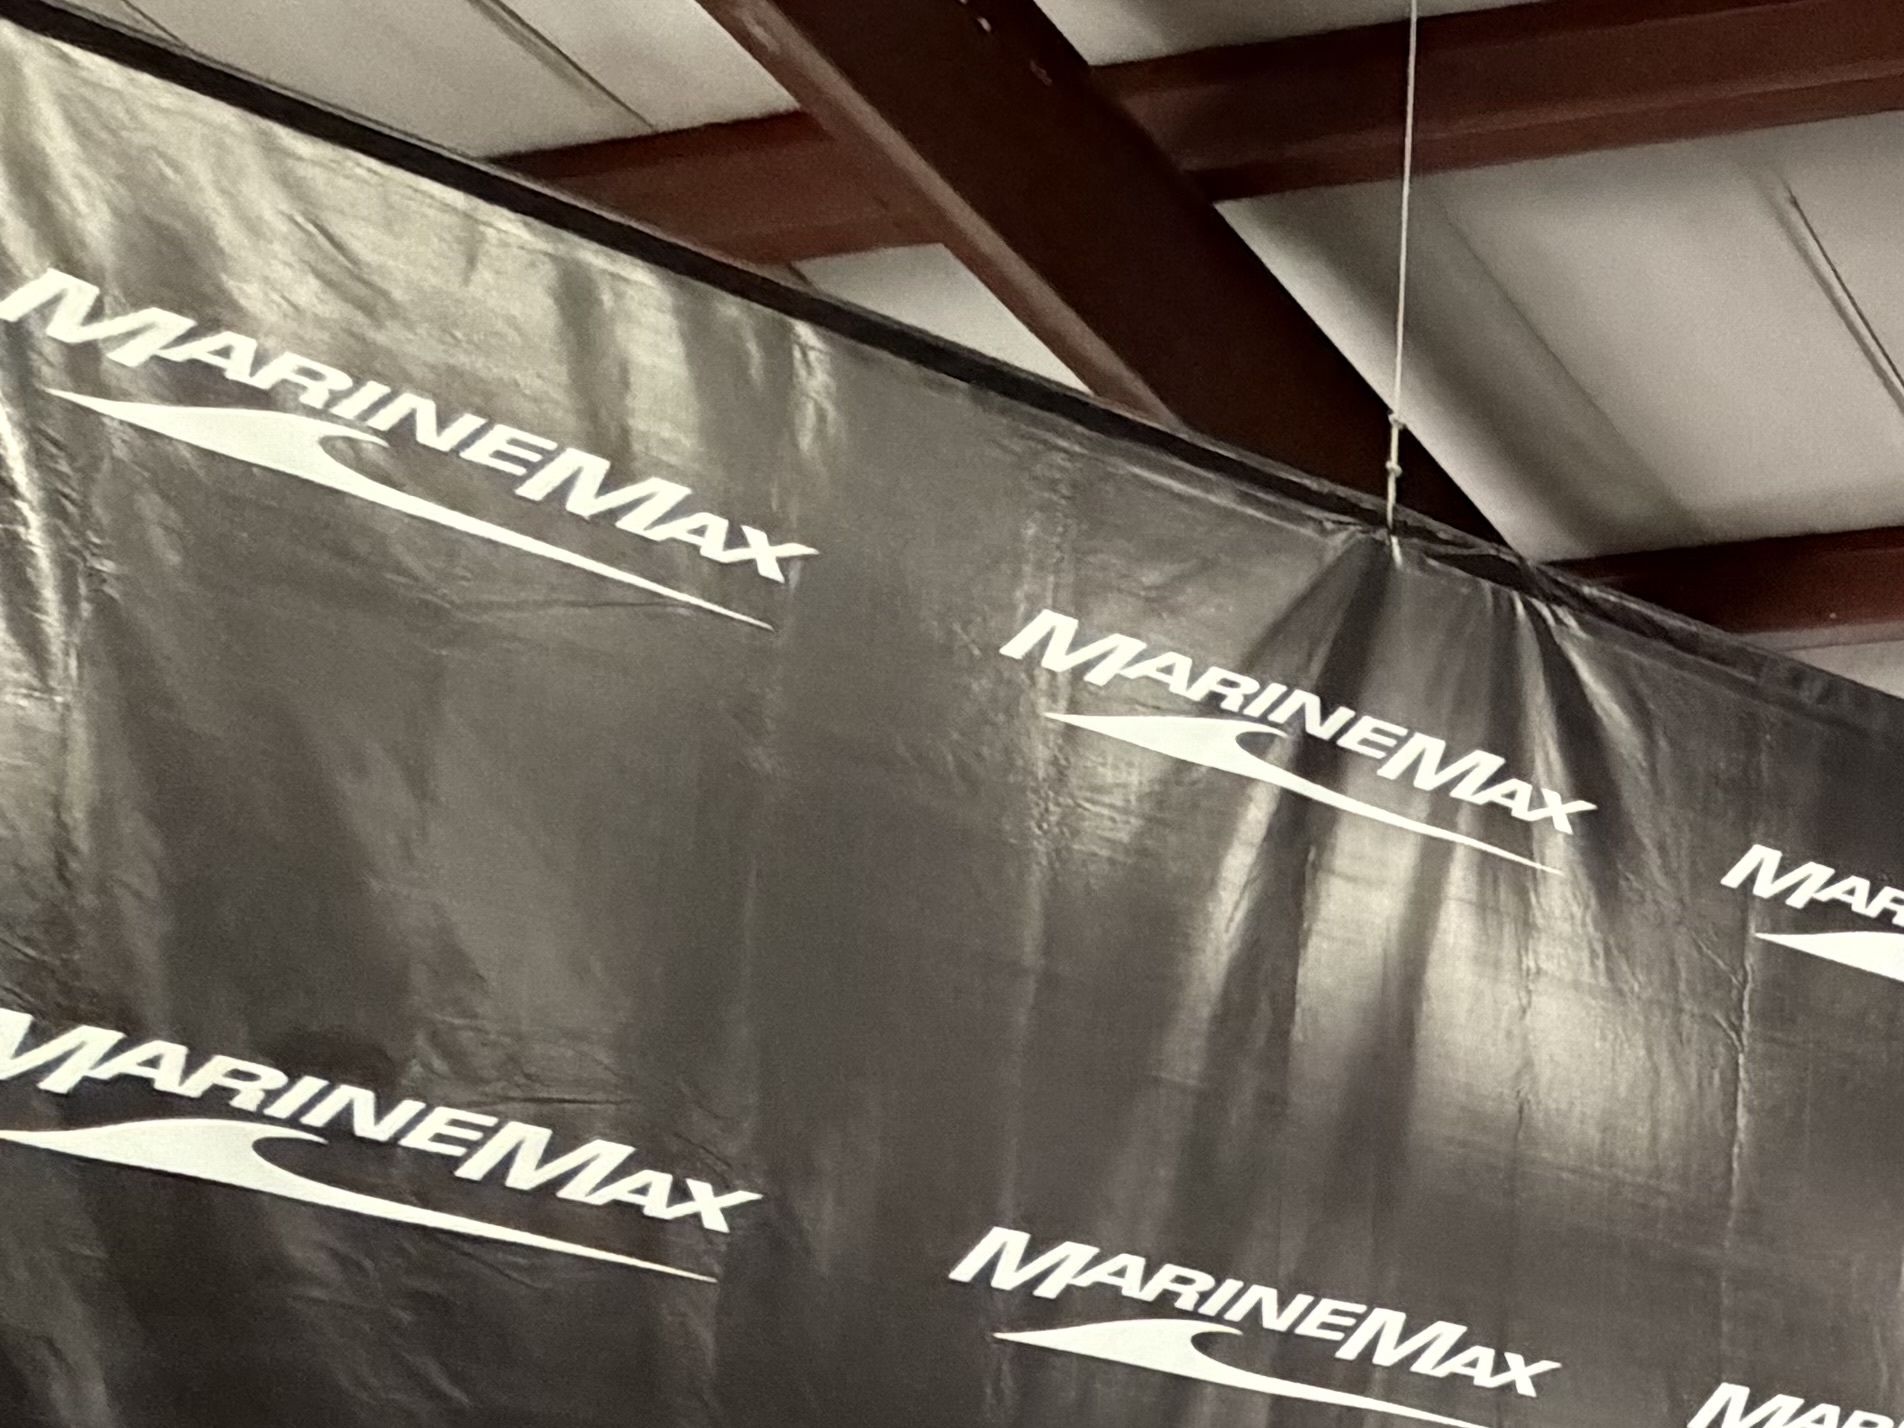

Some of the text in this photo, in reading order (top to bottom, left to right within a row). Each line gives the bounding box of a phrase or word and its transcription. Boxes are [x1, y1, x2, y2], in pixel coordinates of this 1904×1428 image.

[0, 269, 819, 583] MARINEMAX
[1000, 609, 1597, 834] MARINEMAX
[949, 1226, 1561, 1397] MARINEMAX
